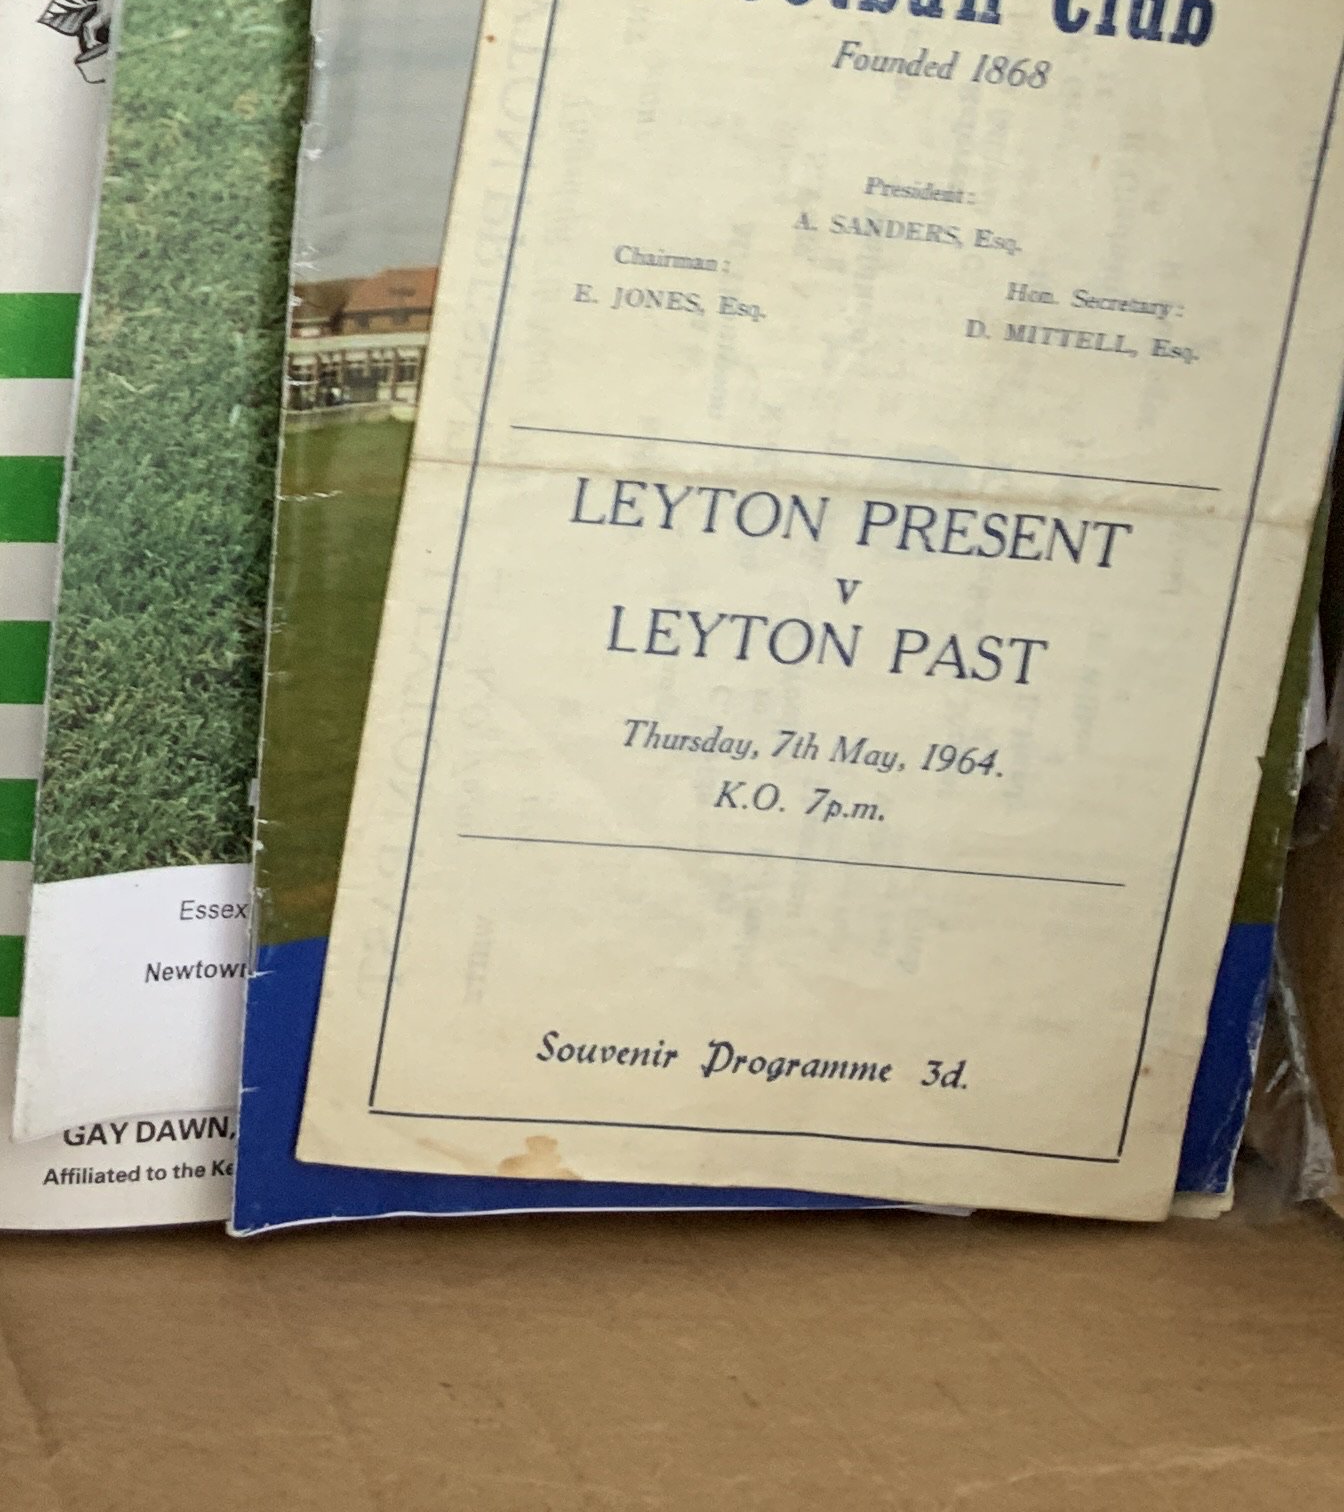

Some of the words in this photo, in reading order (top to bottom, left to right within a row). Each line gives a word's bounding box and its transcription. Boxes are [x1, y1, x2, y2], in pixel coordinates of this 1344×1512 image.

[834, 39, 961, 82] Founded
[972, 52, 1053, 90] 1868
[864, 176, 977, 206] President:
[793, 212, 818, 234] A.
[829, 216, 964, 250] SANDERS,
[973, 228, 1023, 255] Esq.
[614, 244, 731, 274] Chairman:
[572, 283, 599, 304] E.
[610, 286, 707, 317] JONES,
[717, 295, 767, 323] Esq.
[1006, 281, 1060, 306] Hon.
[1071, 288, 1185, 321] Secretary:
[964, 318, 991, 341] D.
[1004, 321, 1138, 359] MITTELL,
[1151, 337, 1200, 364] Esq.
[570, 477, 829, 545] LEYTON
[855, 500, 1133, 569] PRESENT
[607, 605, 864, 671] LEYTON
[888, 628, 1049, 687] PAST
[623, 718, 761, 763] Thursday,
[771, 727, 820, 761] 7th
[830, 733, 907, 773] May,
[922, 742, 1005, 781] 1964.
[714, 780, 788, 814] K.O.
[804, 788, 887, 824] 7p.m.
[179, 899, 249, 921] Essex
[538, 1031, 679, 1072] Souvenir
[701, 1038, 893, 1084] Programme
[921, 1056, 970, 1090] 3d.
[63, 1121, 129, 1147] GAY
[136, 1115, 237, 1144] DAWN,
[43, 1165, 141, 1187] Affiliated
[147, 1165, 167, 1180] to
[173, 1161, 206, 1179] the
